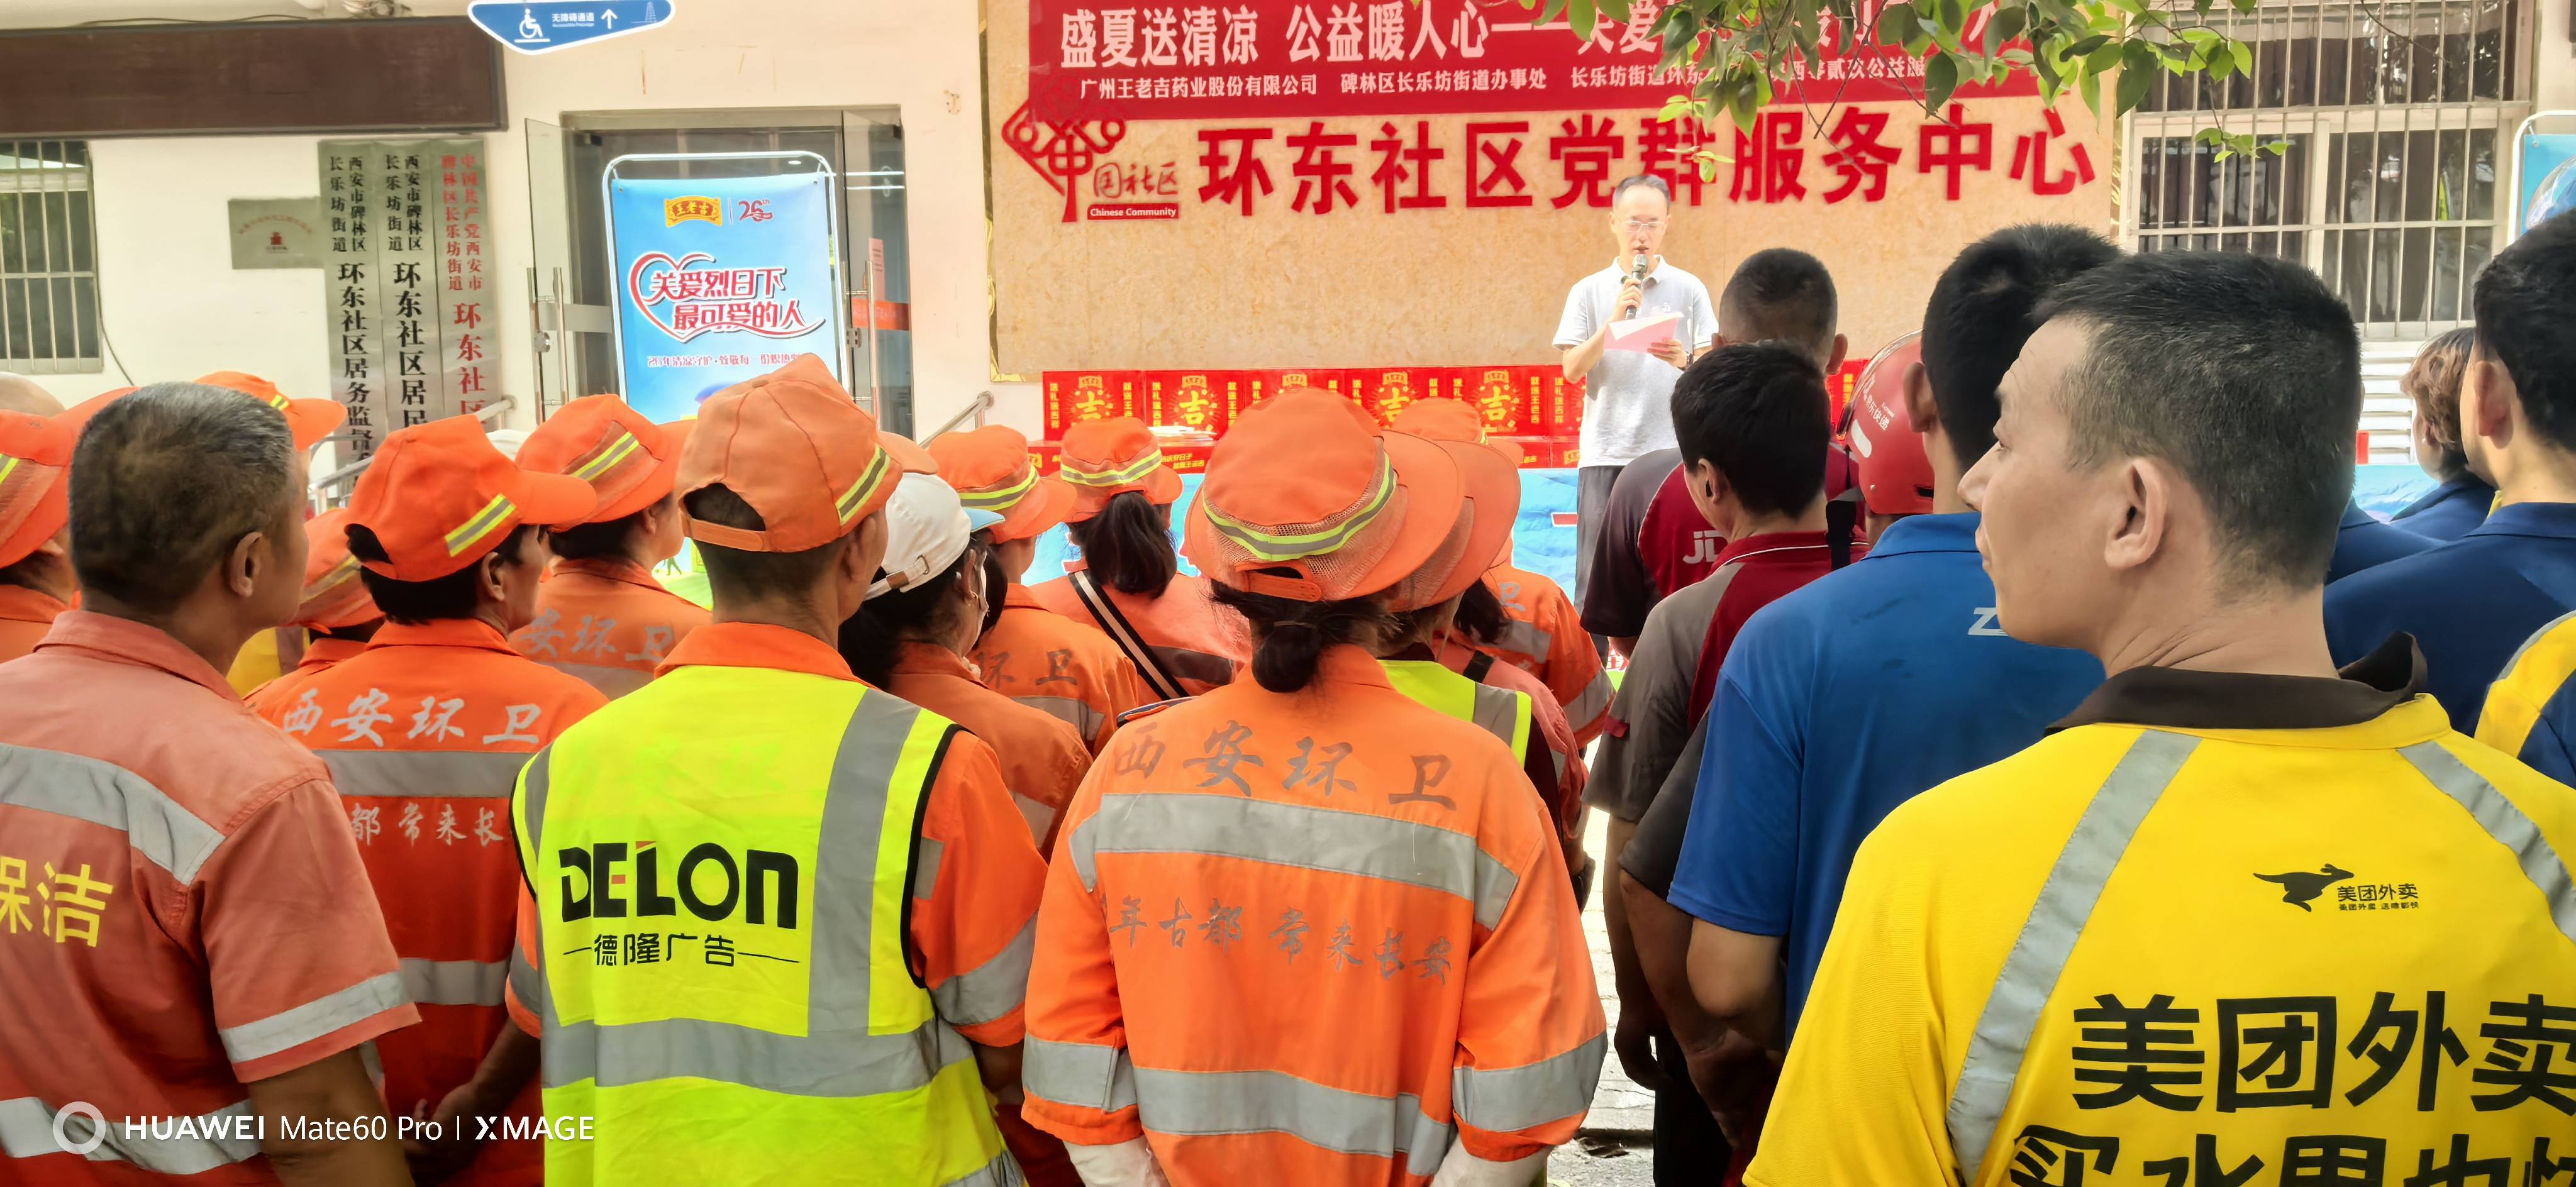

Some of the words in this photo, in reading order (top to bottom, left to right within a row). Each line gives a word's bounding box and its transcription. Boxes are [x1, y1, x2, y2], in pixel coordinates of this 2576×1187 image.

[552, 13, 594, 22] 无障碍通道
[1061, 6, 1259, 68] 盛夏送清凉
[1080, 74, 1318, 99] 广州王老吉药业股份有限公司
[1340, 67, 1547, 94] 碑林区长乐坊街道办事处
[1198, 104, 2096, 218] 环东社区党群服务中心
[330, 157, 347, 251] 长乐坊街道
[348, 157, 367, 251] 西安市碑林区
[386, 155, 403, 251] 长乐坊街道
[405, 155, 423, 251] 西安市碑林区
[460, 153, 483, 291] 中国共产党西安市
[674, 201, 711, 216] 王老吉
[1126, 207, 1177, 218] Community
[650, 268, 784, 301] 关爱烈日下
[674, 301, 806, 330] 最可爱的人
[1179, 390, 1209, 425] 吉
[1480, 385, 1511, 421] 吉
[283, 687, 542, 748] 西安环卫
[1114, 719, 1457, 812] 西安环卫
[2337, 883, 2419, 902] 美团外卖
[594, 932, 736, 968] 德隆广告
[2072, 990, 2576, 1117] 美团外卖
